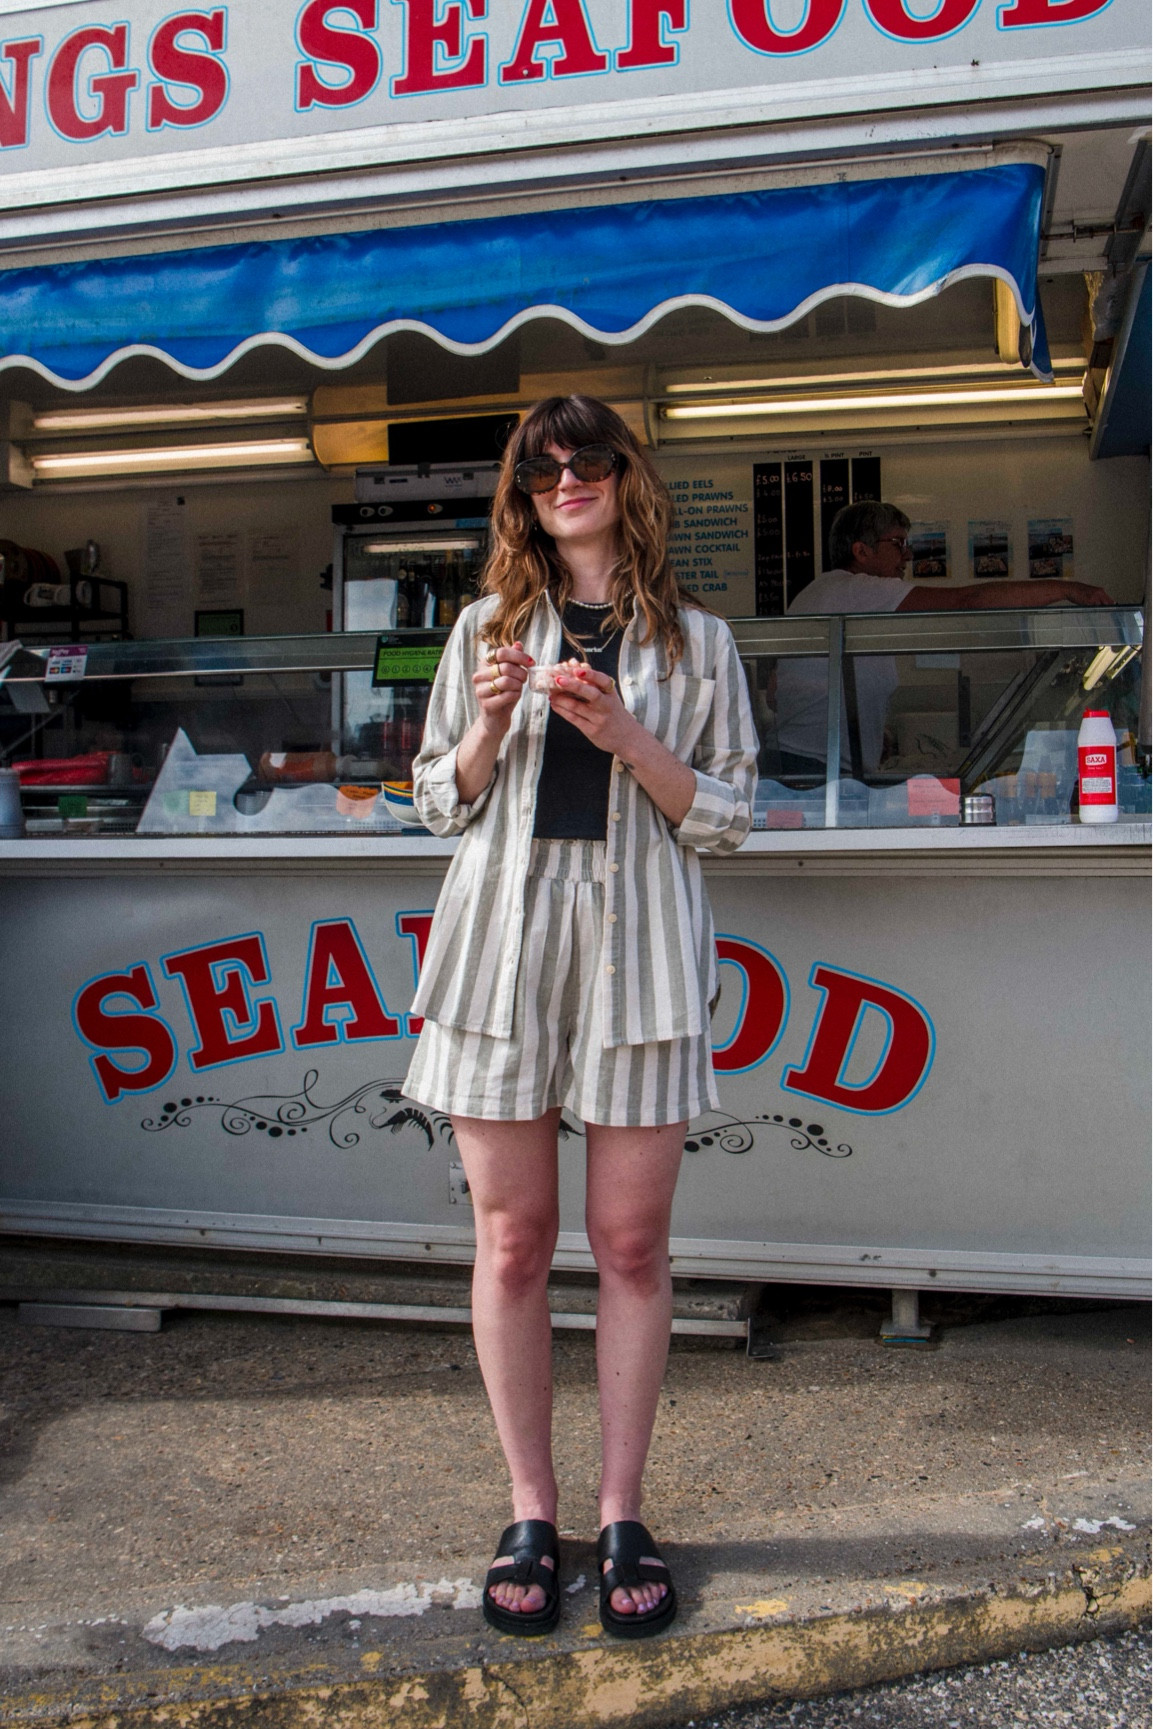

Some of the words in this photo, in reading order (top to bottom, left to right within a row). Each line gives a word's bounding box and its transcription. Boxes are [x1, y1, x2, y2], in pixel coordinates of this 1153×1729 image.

[669, 481, 690, 490] LIED
[692, 479, 714, 489] EELS
[692, 491, 734, 502] PRAWNS
[706, 503, 748, 514] PRAWNS
[683, 517, 737, 528] SANDWICH
[668, 532, 691, 542] AWN
[694, 529, 749, 541] SANDWICH
[668, 545, 692, 555] AWN
[695, 543, 741, 554] COCKTAIL
[670, 558, 689, 568] EAN
[692, 557, 713, 567] STIX
[675, 570, 697, 580] STER
[699, 569, 719, 579] TAIL
[702, 582, 728, 592] CRAB
[427, 648, 443, 656] RATI
